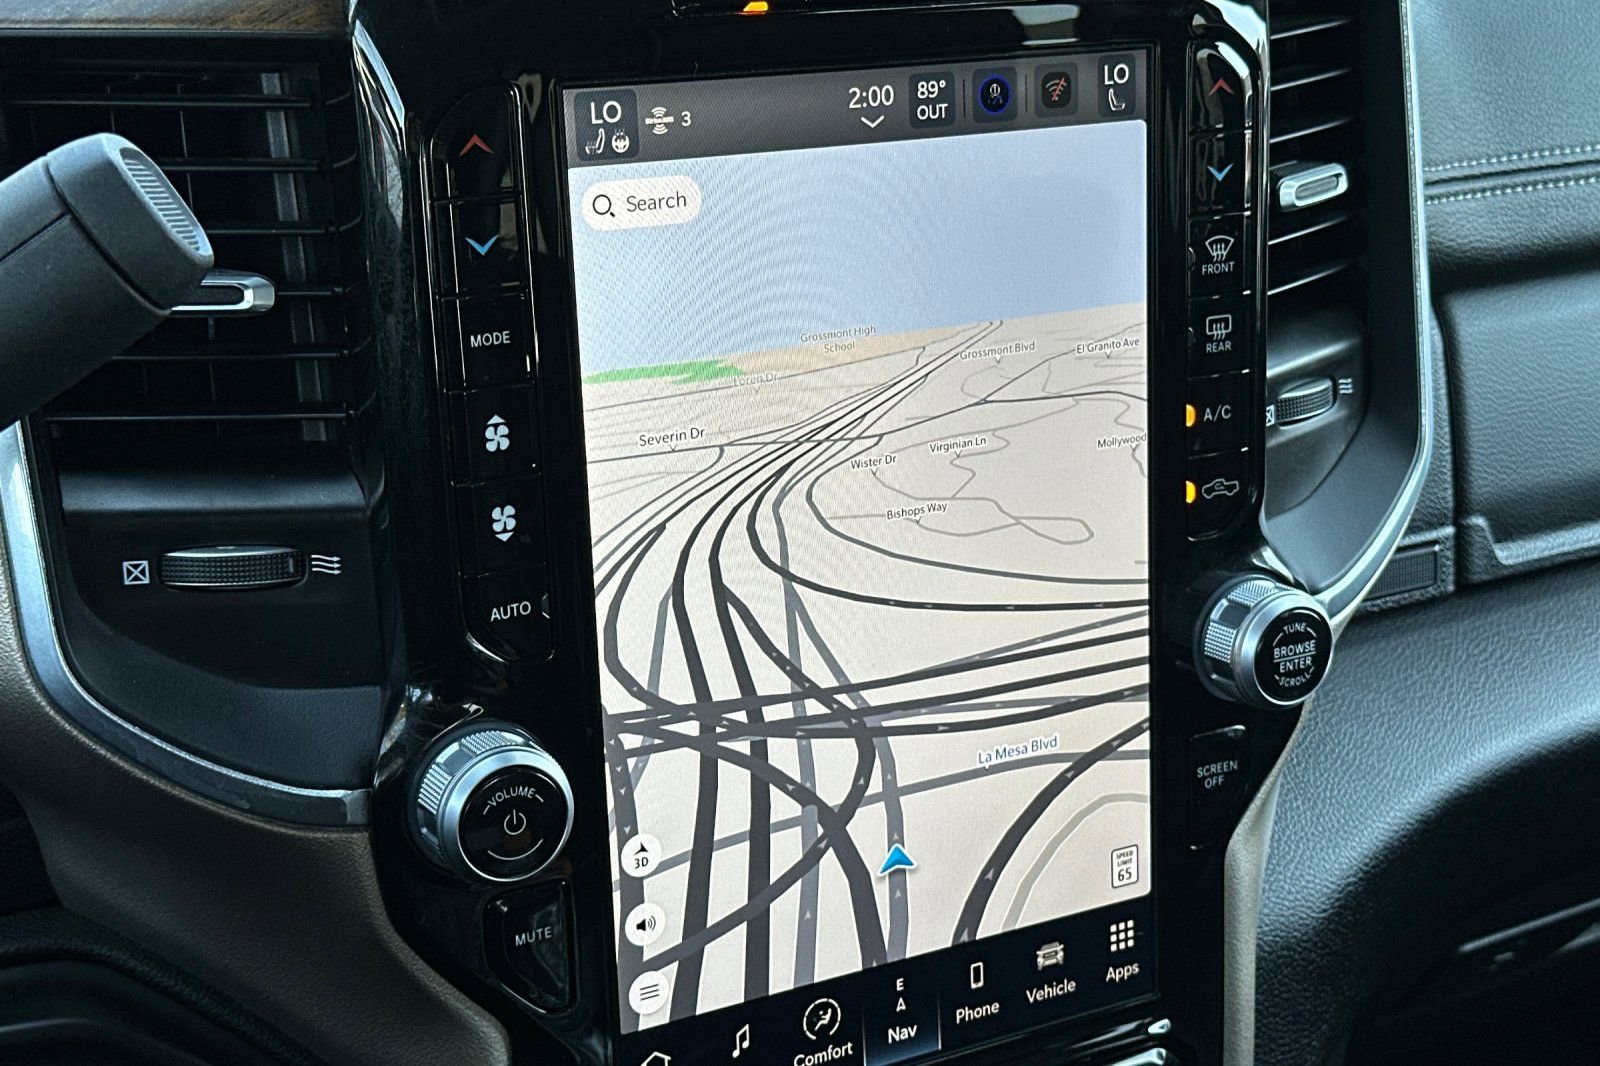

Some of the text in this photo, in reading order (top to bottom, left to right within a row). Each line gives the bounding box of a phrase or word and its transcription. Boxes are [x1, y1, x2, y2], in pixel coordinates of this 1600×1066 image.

[1104, 63, 1129, 86] LO
[849, 85, 894, 108] 2:00
[917, 79, 946, 99] 89°
[590, 101, 622, 124] LO
[681, 111, 691, 127] 3
[917, 103, 948, 120] OUT
[626, 191, 687, 212] Search
[1202, 262, 1235, 275] FRONT
[470, 331, 511, 348] MODE
[800, 325, 876, 343] Grossmont High
[824, 340, 856, 353] School
[959, 341, 1036, 361] Grossmont Blvd
[1076, 337, 1140, 354] El Granito Ave
[1206, 340, 1232, 353] REAR
[1203, 405, 1231, 422] A/C
[639, 427, 706, 447] Severin Dr
[929, 436, 987, 453] Virginian Ln
[1097, 431, 1147, 449] Mollywood
[850, 454, 897, 470] Wister Dr
[886, 502, 948, 520] Bishops Way
[490, 601, 531, 621] AUTO
[1283, 622, 1307, 635] TUNE
[1273, 640, 1316, 658] BROWSE
[1279, 656, 1312, 673] ENTER
[1279, 672, 1311, 687] SCROLL
[978, 736, 1058, 764] La Mesa Blvd
[1197, 760, 1238, 778] SCREEN
[1204, 775, 1225, 789] OFF
[487, 785, 536, 807] VOLUME
[634, 856, 649, 869] 3D
[1116, 850, 1134, 860] SPEED
[1118, 867, 1132, 882] 65
[515, 928, 552, 946] MUTE
[1105, 961, 1140, 983] Apps
[896, 978, 904, 991] E
[1026, 978, 1076, 1003] Vehicle
[956, 1001, 1000, 1024] Phone
[888, 1024, 918, 1044] Nav
[793, 1041, 853, 1066] Comfort
